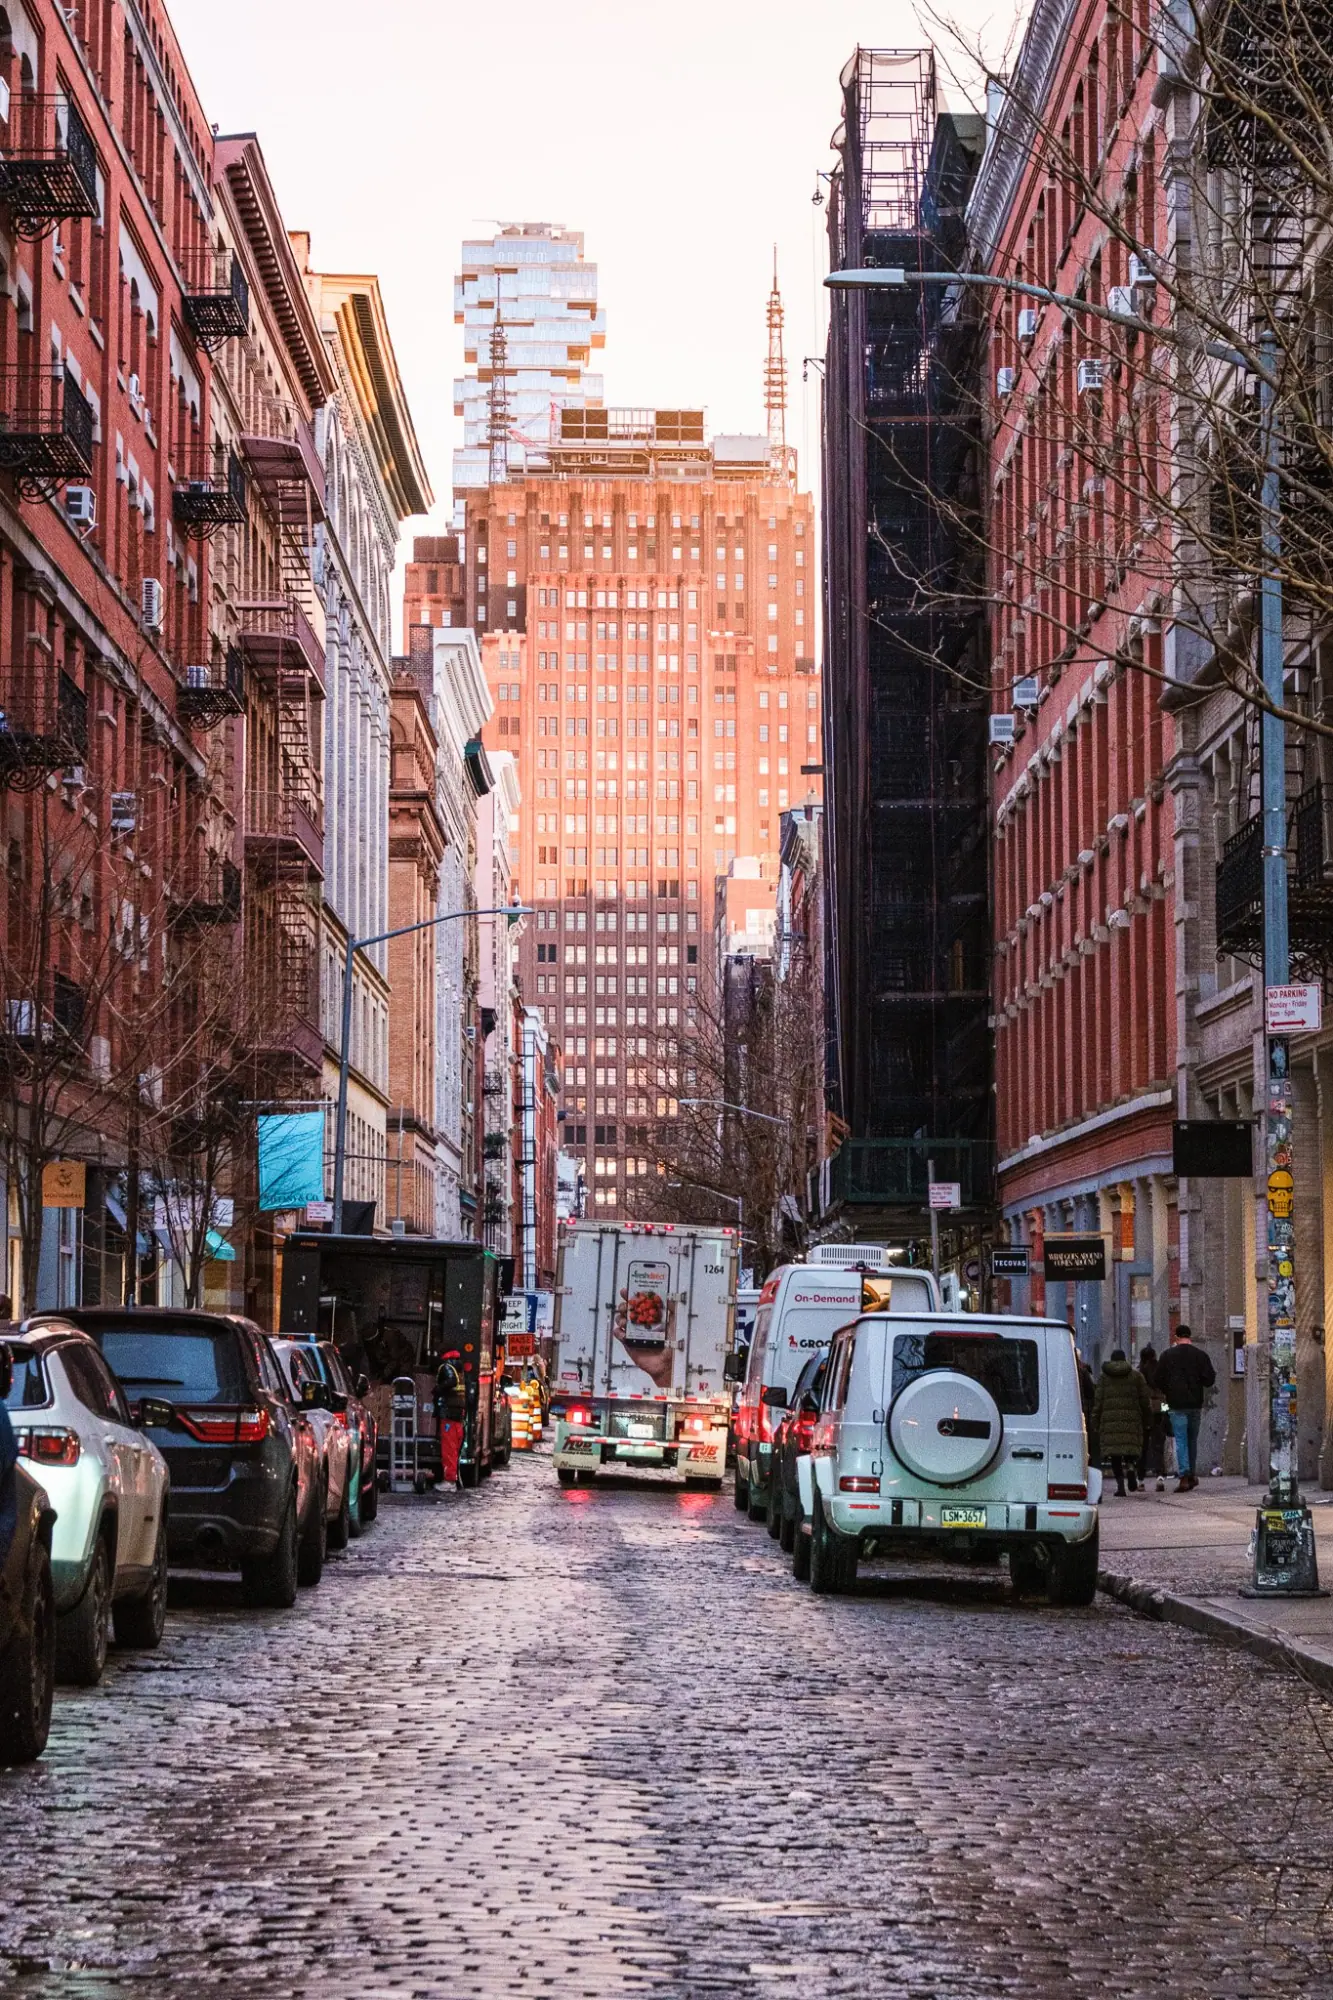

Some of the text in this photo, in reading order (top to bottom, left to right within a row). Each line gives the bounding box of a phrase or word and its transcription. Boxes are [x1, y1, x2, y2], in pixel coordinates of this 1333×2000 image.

[1280, 989, 1308, 998] PARKING
[704, 1264, 724, 1274] 1264
[794, 1294, 855, 1303] On-Demand
[502, 1322, 523, 1330] RIGHT
